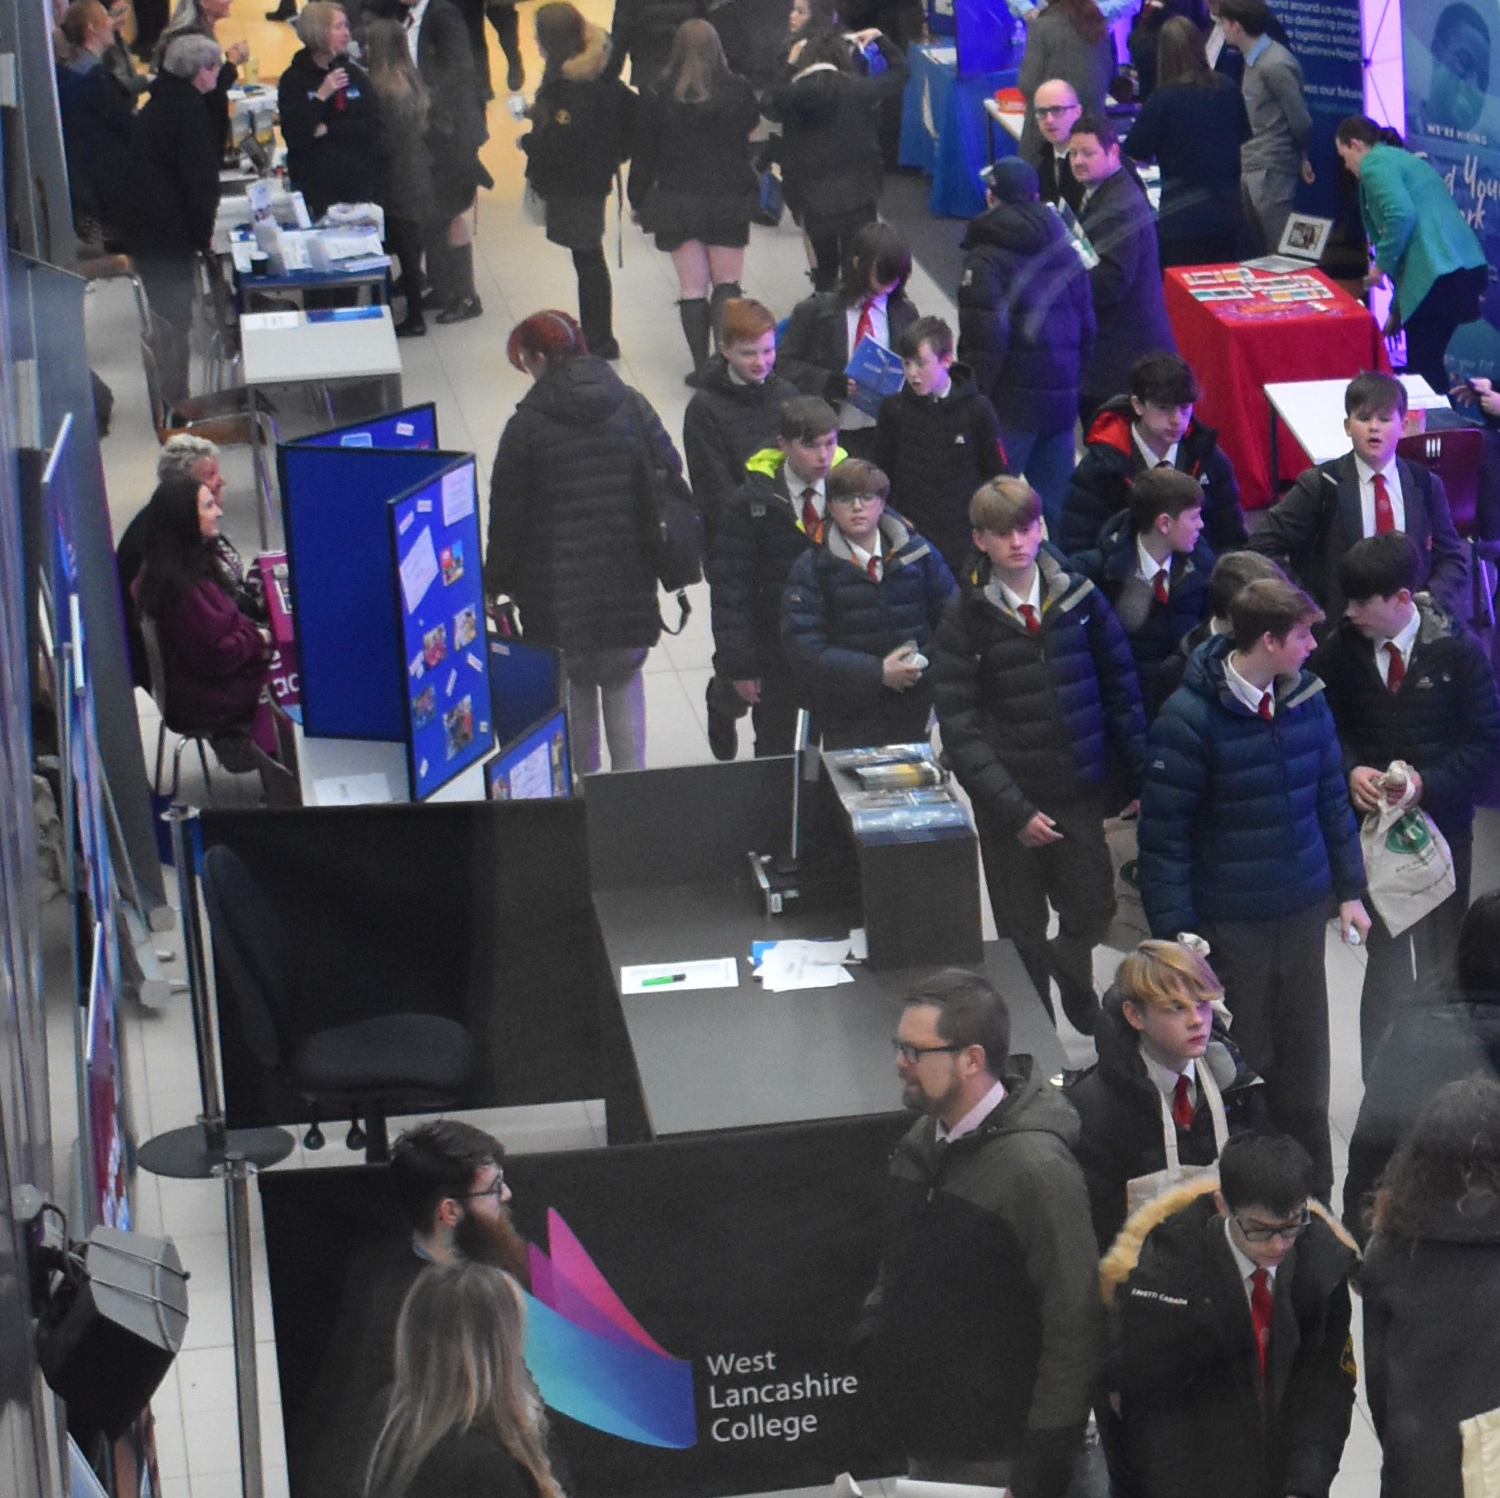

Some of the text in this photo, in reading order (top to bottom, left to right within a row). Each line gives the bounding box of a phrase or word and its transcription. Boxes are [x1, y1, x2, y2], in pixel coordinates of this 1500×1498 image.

[1427, 123, 1488, 146] WE'RE HIRING
[706, 1350, 776, 1376] West
[709, 1372, 859, 1409] Lancashire
[711, 1413, 818, 1442] College
